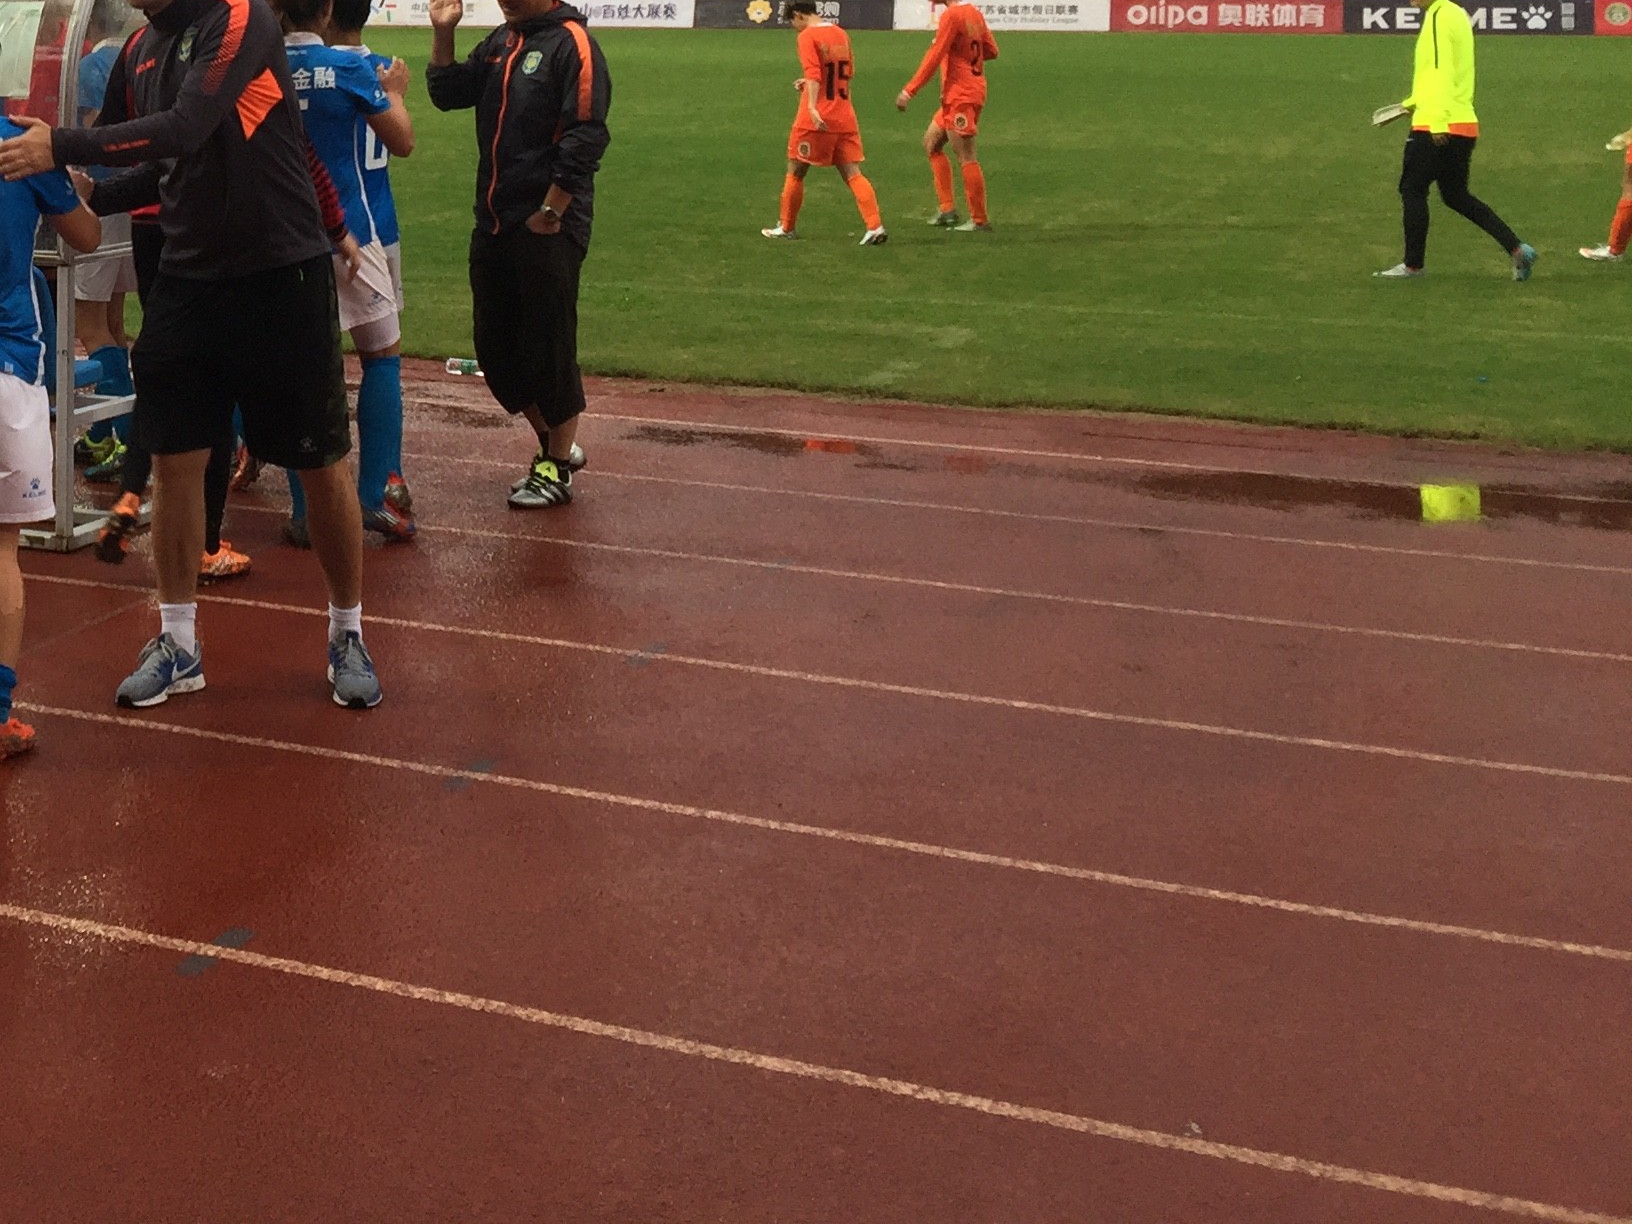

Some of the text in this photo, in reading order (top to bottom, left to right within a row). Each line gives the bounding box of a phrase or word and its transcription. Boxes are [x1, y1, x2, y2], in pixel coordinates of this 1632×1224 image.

[1218, 3, 1325, 28] 奥联体育
[1363, 7, 1518, 30] KEME
[291, 67, 336, 90] 金融
[825, 60, 850, 101] 15
